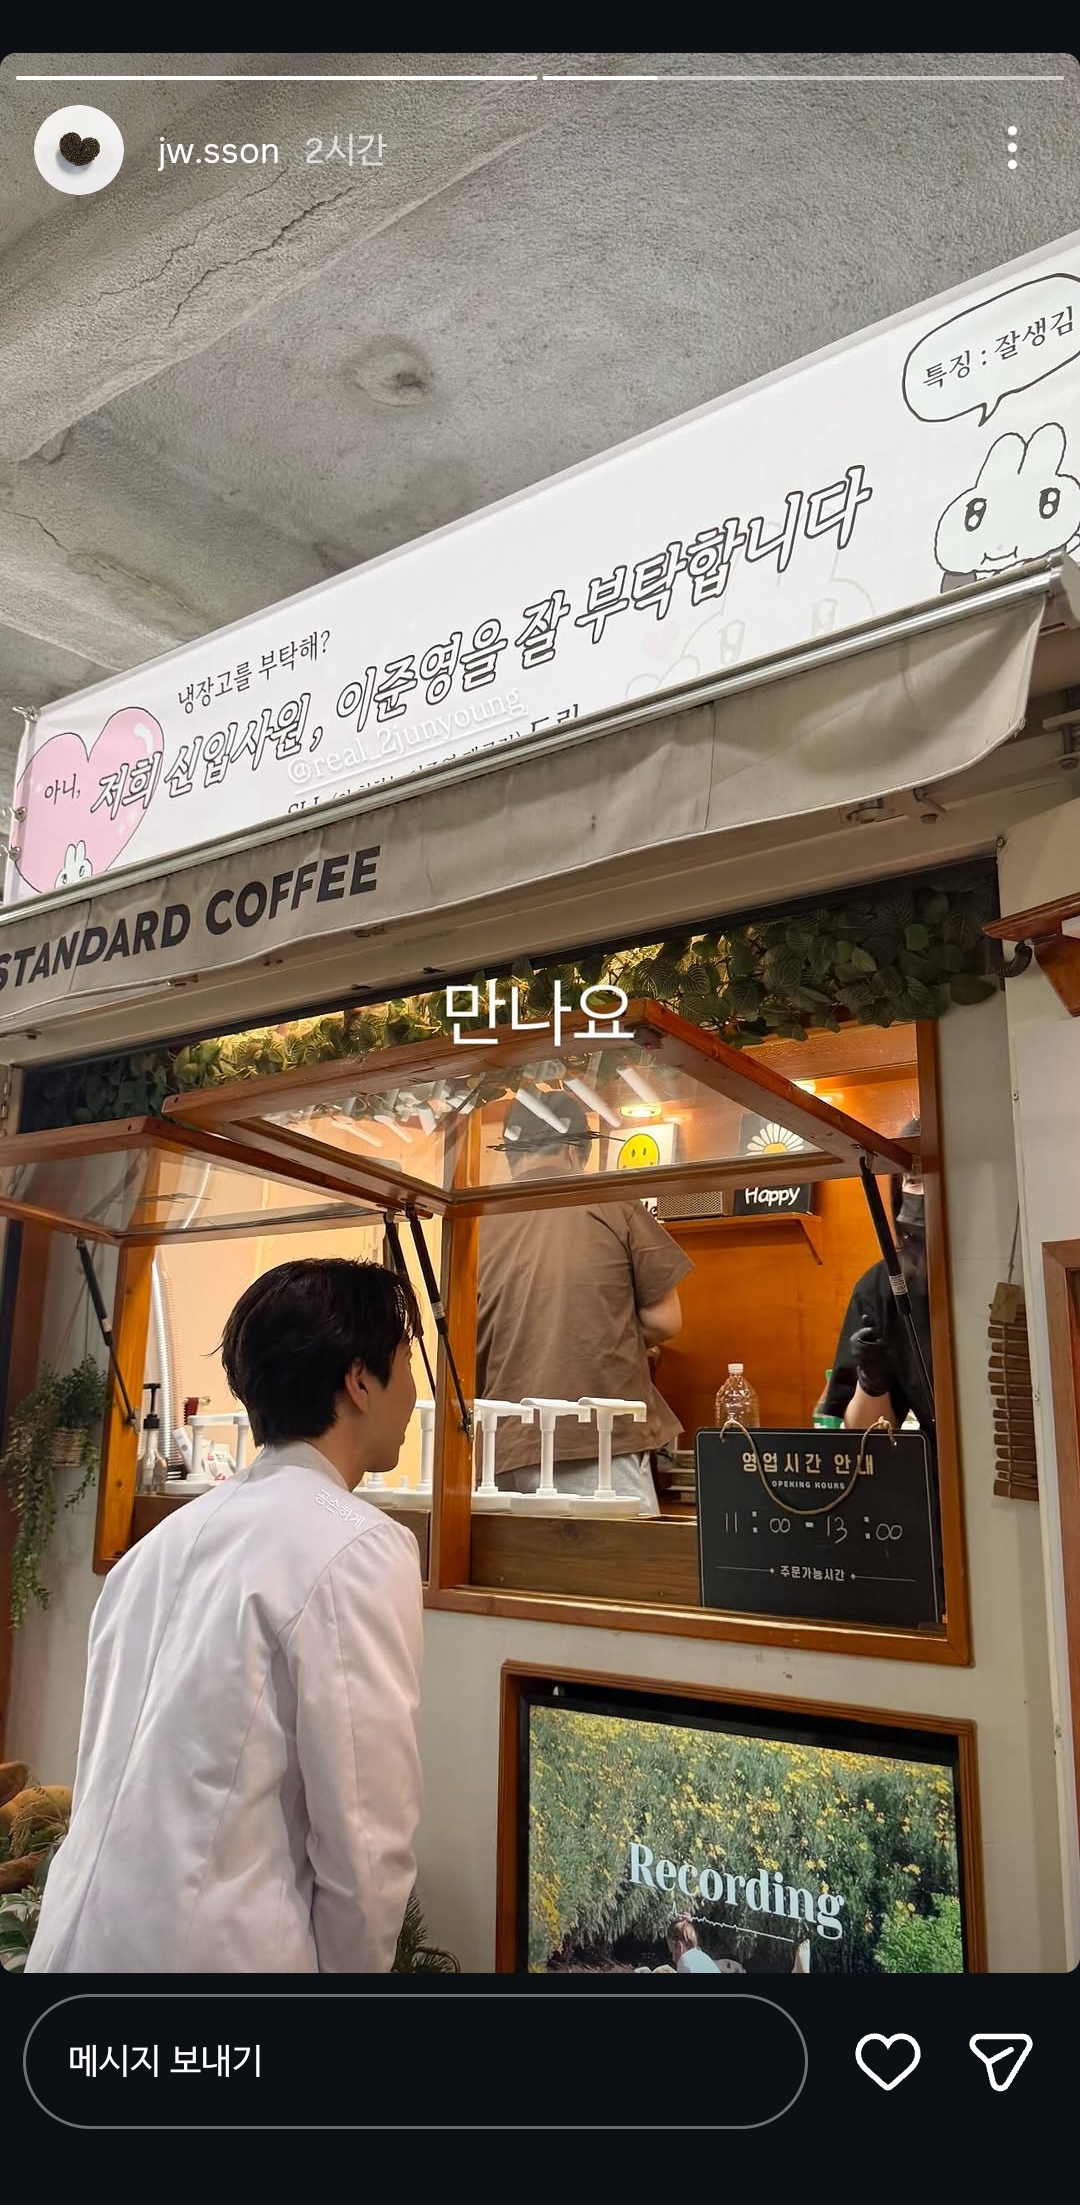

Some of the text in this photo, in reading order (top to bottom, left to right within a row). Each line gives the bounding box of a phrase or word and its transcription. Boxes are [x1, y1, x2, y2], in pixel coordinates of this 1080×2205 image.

[922, 349, 972, 388] 특징
[993, 305, 1074, 361] 잘생김
[43, 772, 82, 806] 아니,
[89, 750, 164, 821] 저희
[163, 692, 325, 799] 신입사원,
[335, 617, 509, 733] 이준영을
[514, 588, 572, 671] 잘
[573, 464, 874, 645] 부탁합니다
[177, 630, 331, 715] 냉장고를 부탁해?
[0, 844, 382, 992] STANDARD COFFEE
[744, 1185, 801, 1208] Happy
[741, 1451, 875, 1477] 영업시간 안내
[771, 1479, 846, 1491] OPENING HOURS
[779, 1564, 846, 1582] 주문가능시간
[628, 1841, 845, 1941] Recording
